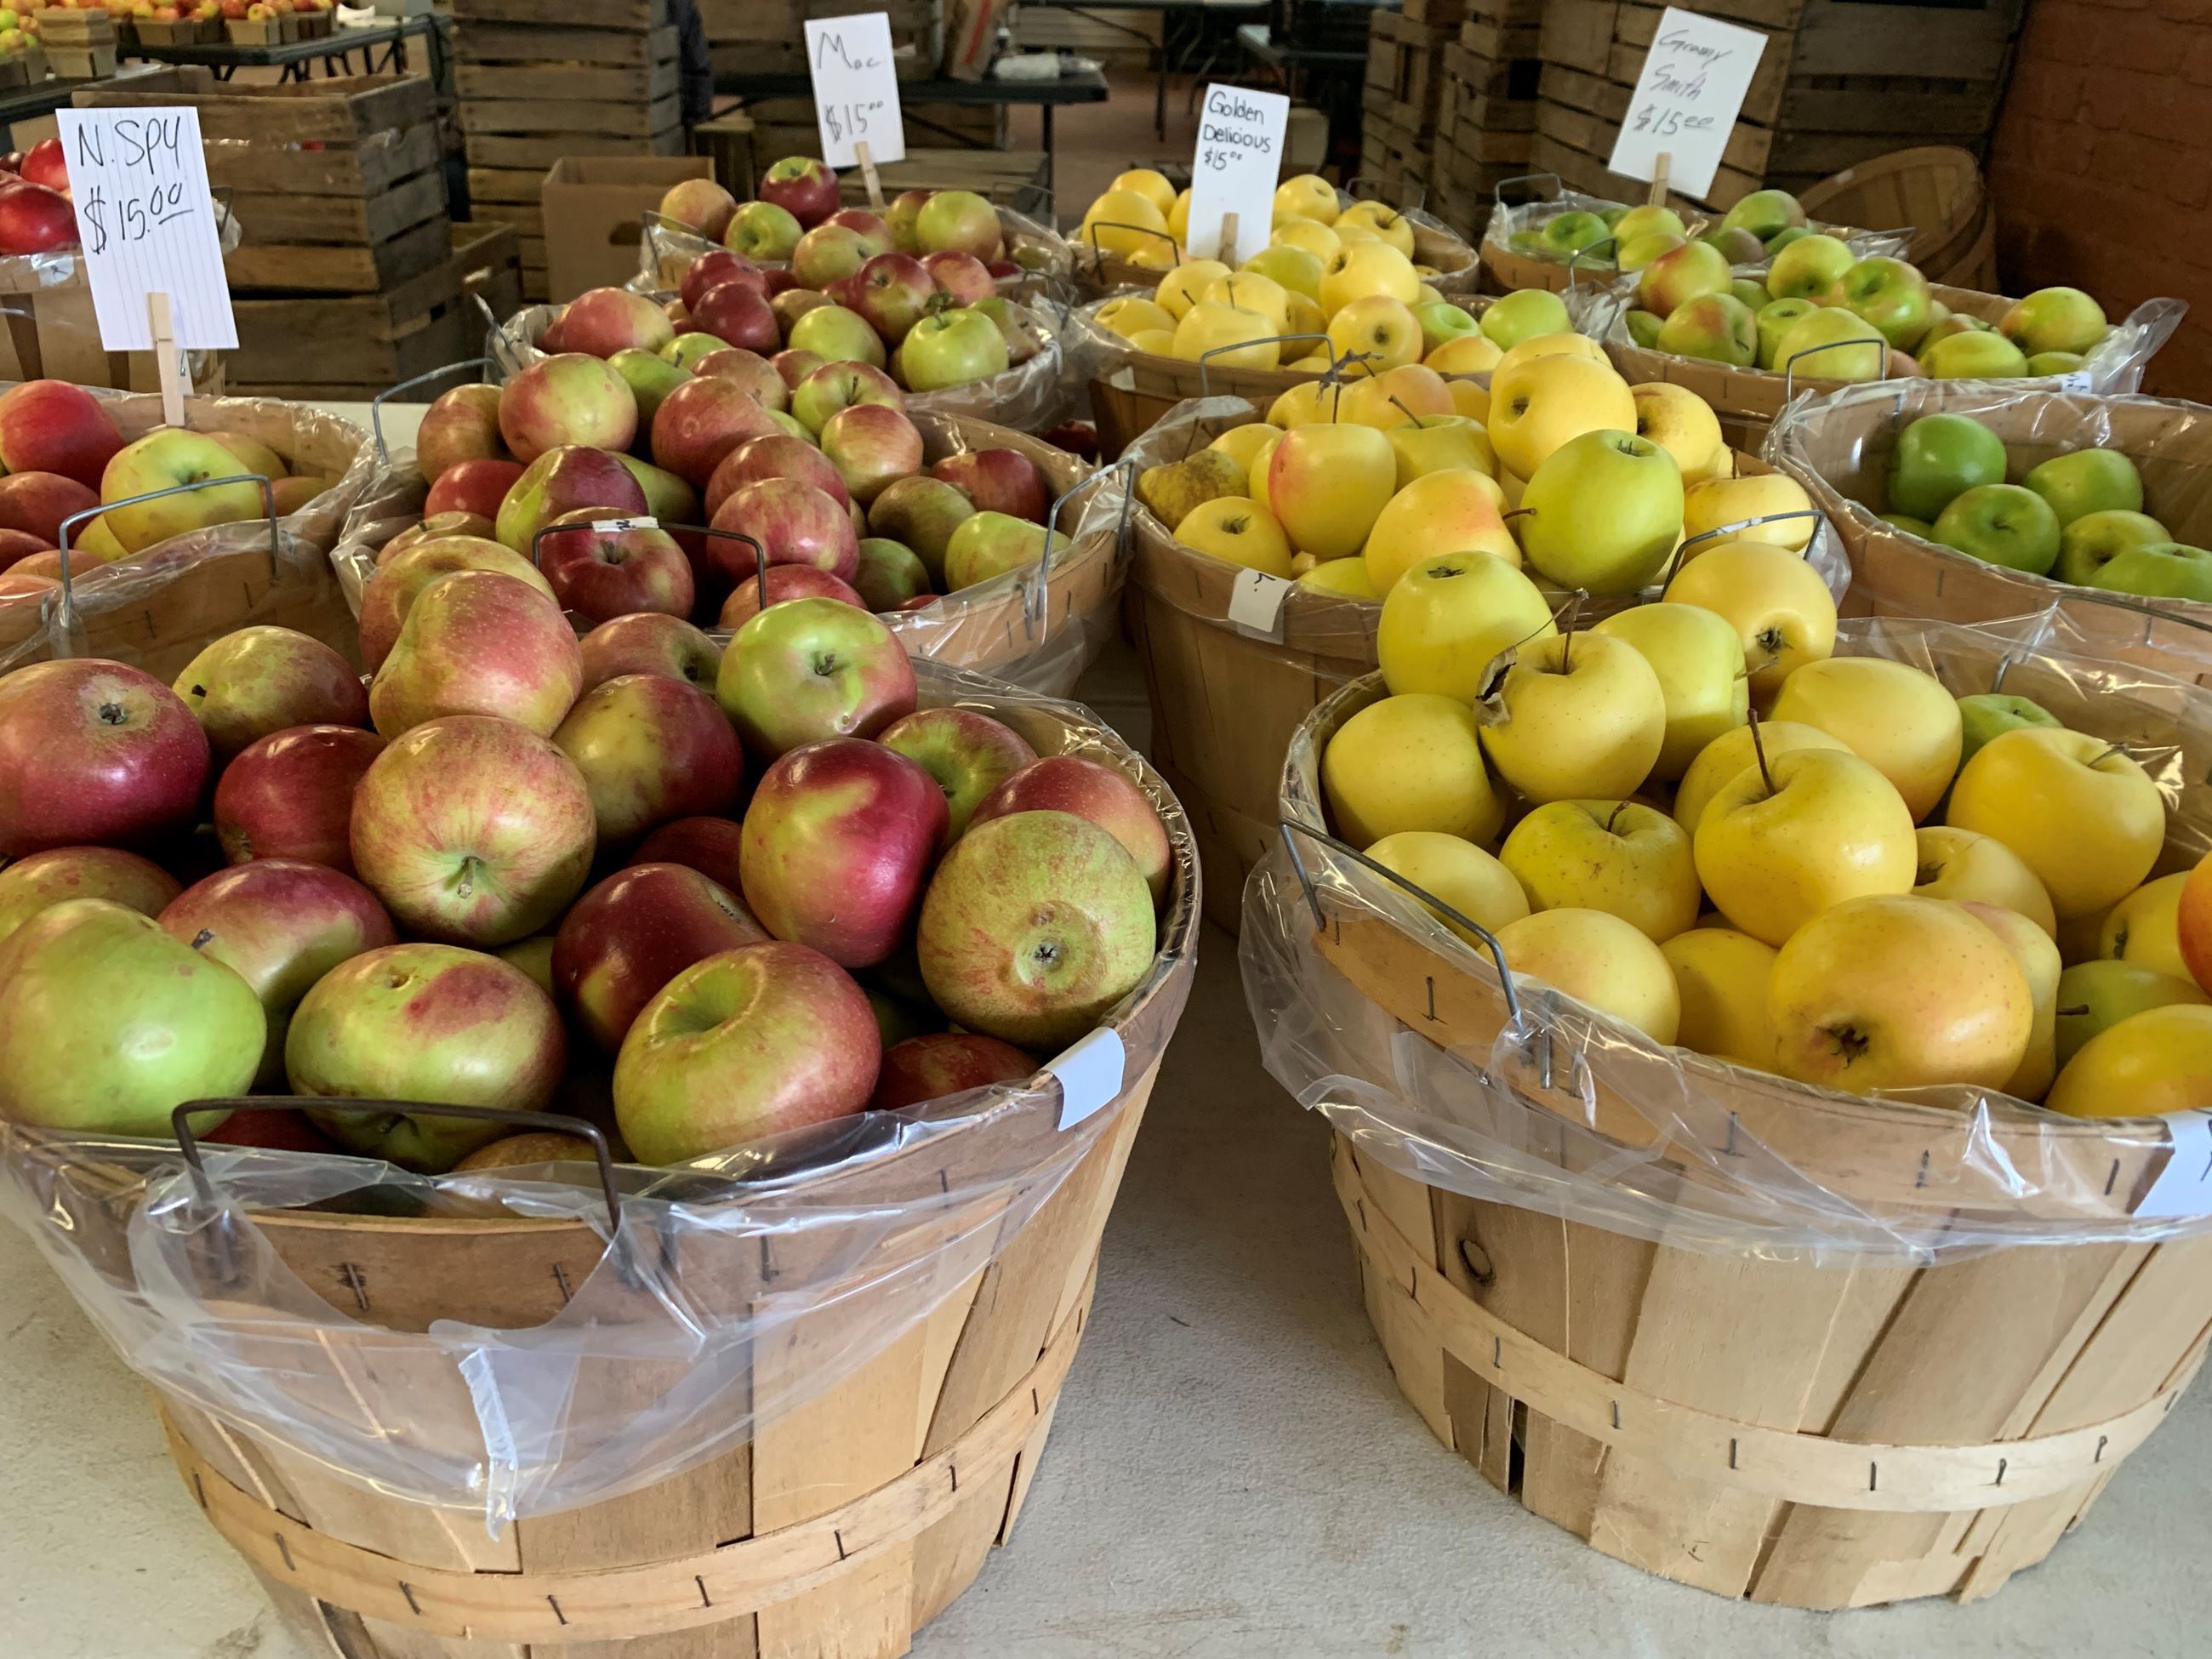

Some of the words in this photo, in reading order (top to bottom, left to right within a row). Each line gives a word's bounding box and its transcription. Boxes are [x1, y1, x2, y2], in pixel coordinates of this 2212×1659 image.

[818, 31, 881, 70] Mac
[1649, 63, 1707, 101] Smith
[1208, 90, 1265, 125] Golden
[1203, 123, 1272, 153] Delicious
